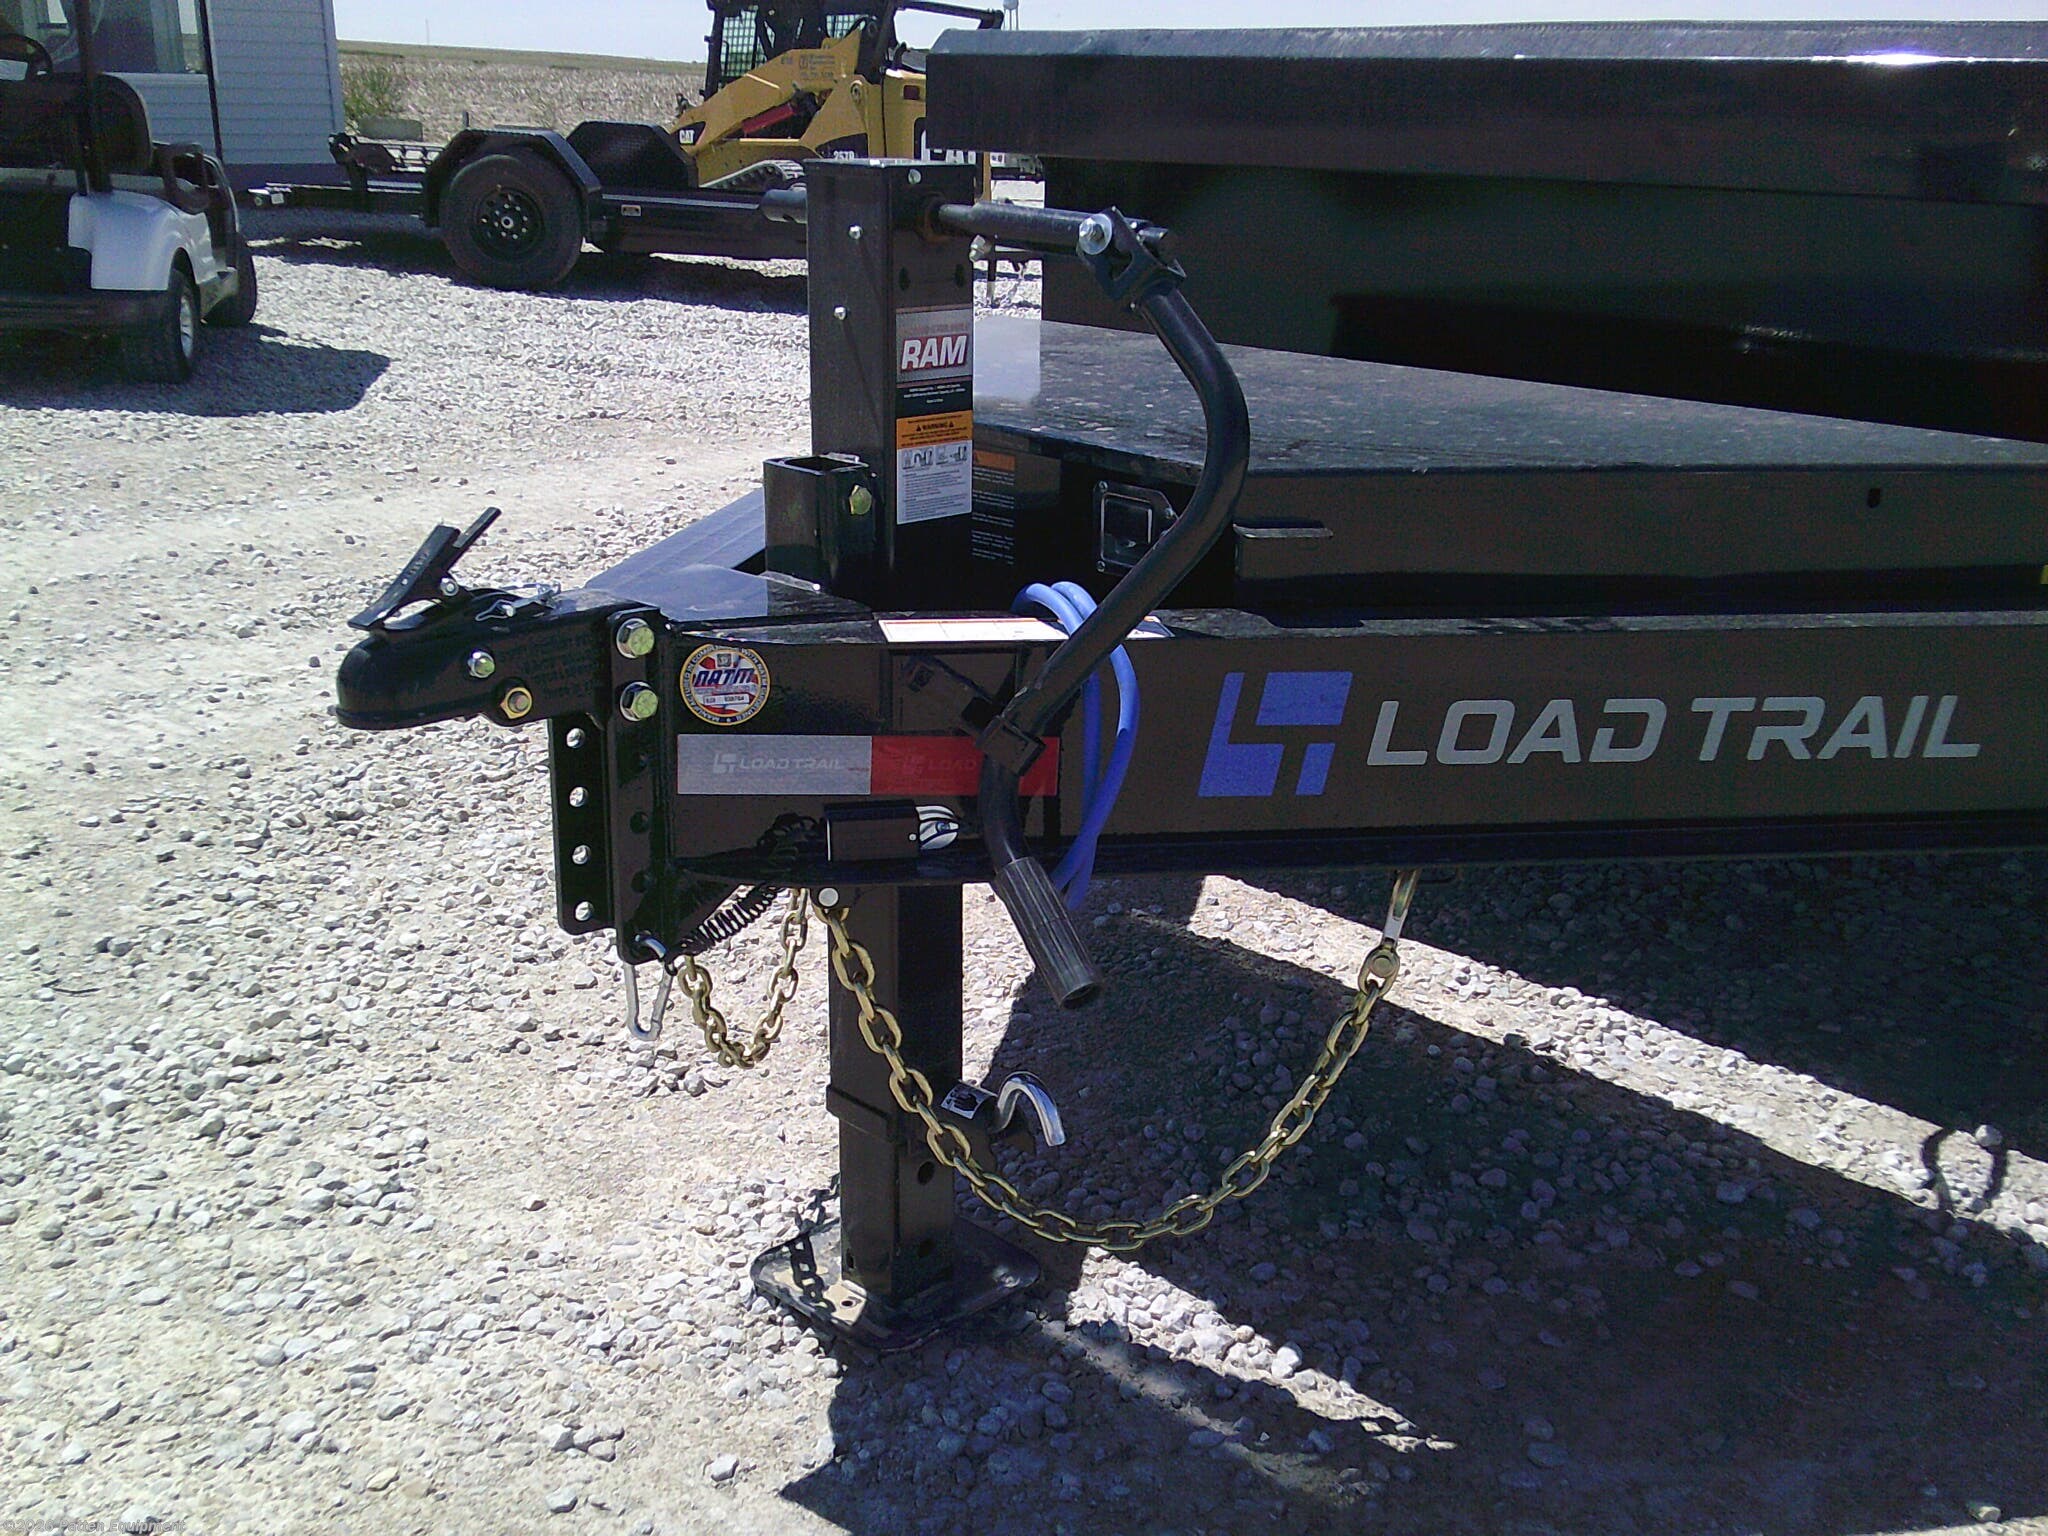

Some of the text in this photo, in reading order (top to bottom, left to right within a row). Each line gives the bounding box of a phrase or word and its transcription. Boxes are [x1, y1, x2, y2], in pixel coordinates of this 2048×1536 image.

[679, 130, 694, 144] CAT
[901, 335, 968, 371] RAM
[694, 668, 755, 688] NATM
[1366, 699, 1668, 766] LOAD
[1691, 695, 1981, 762] TRAIL
[738, 758, 791, 770] LOAD
[792, 757, 843, 770] TRAIL
